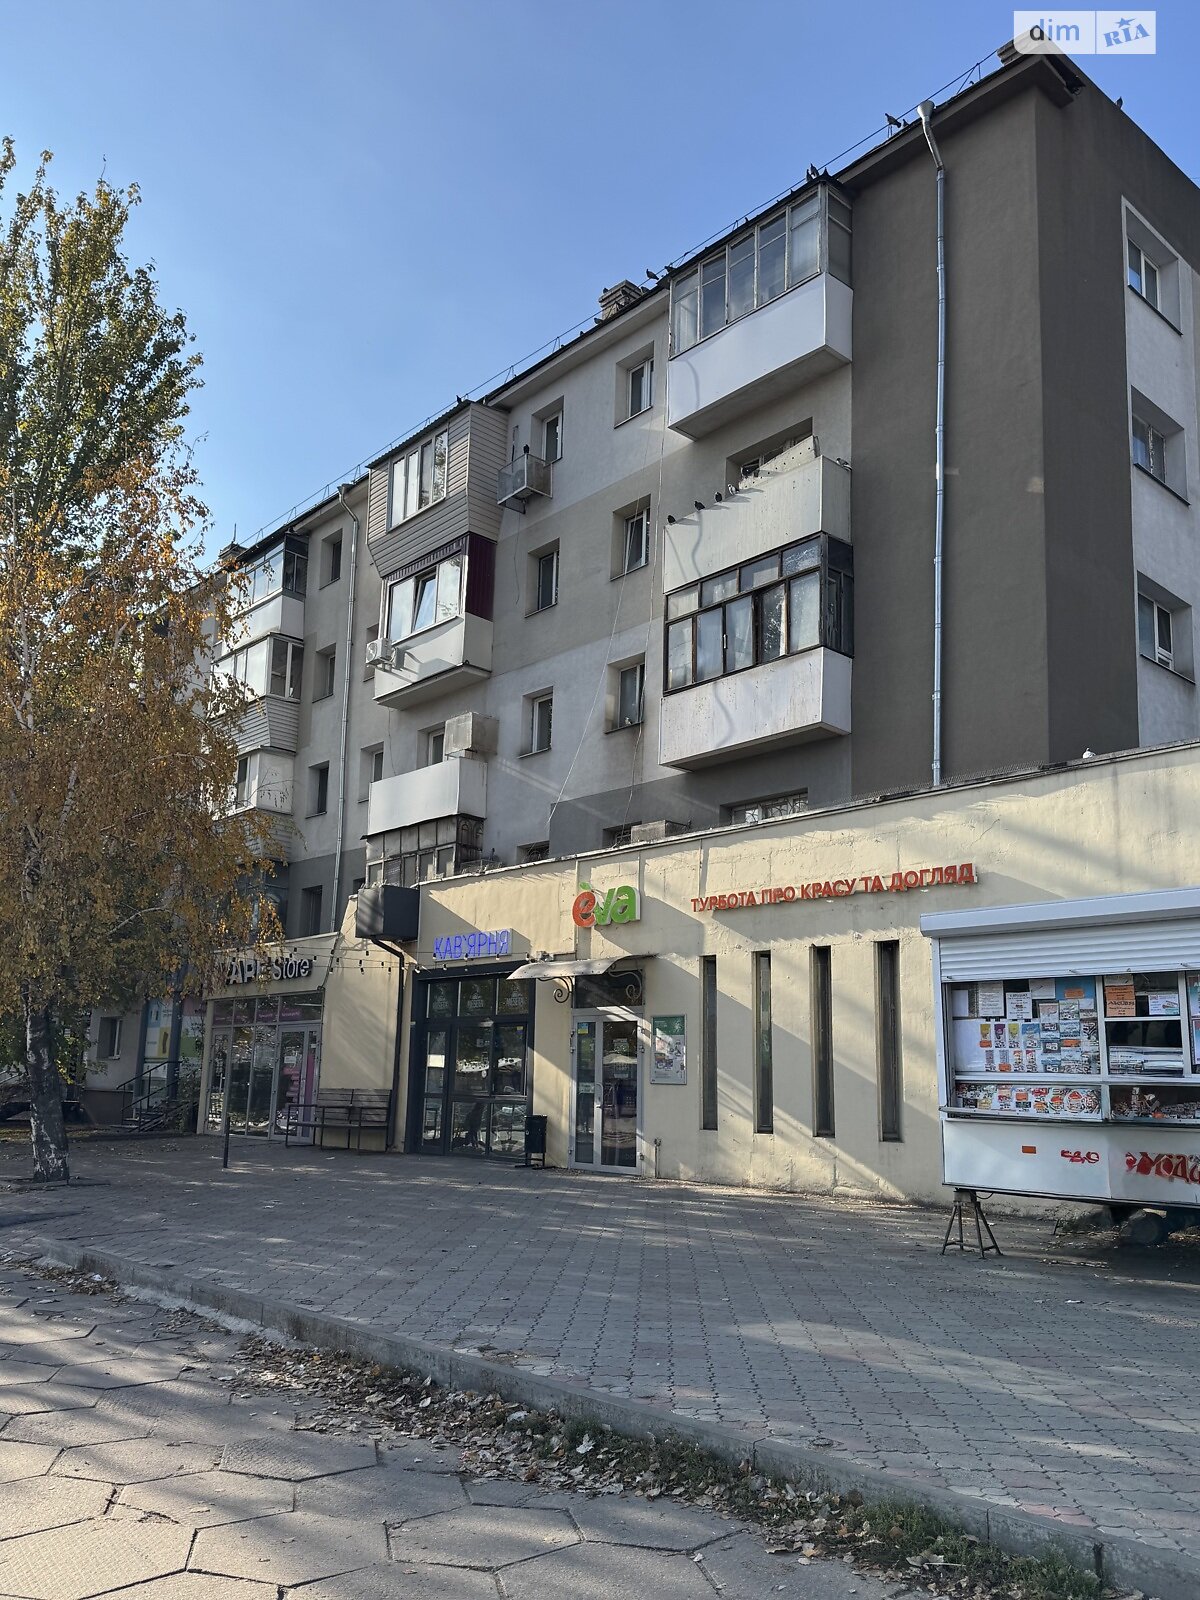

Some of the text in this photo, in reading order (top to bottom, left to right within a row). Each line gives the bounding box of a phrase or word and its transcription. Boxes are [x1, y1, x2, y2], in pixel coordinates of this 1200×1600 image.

[572, 885, 640, 928] eva
[690, 862, 976, 913] ТУРБОТА ПРО КРАСУ ТА ДОГЛЯД
[272, 956, 310, 981] Store
